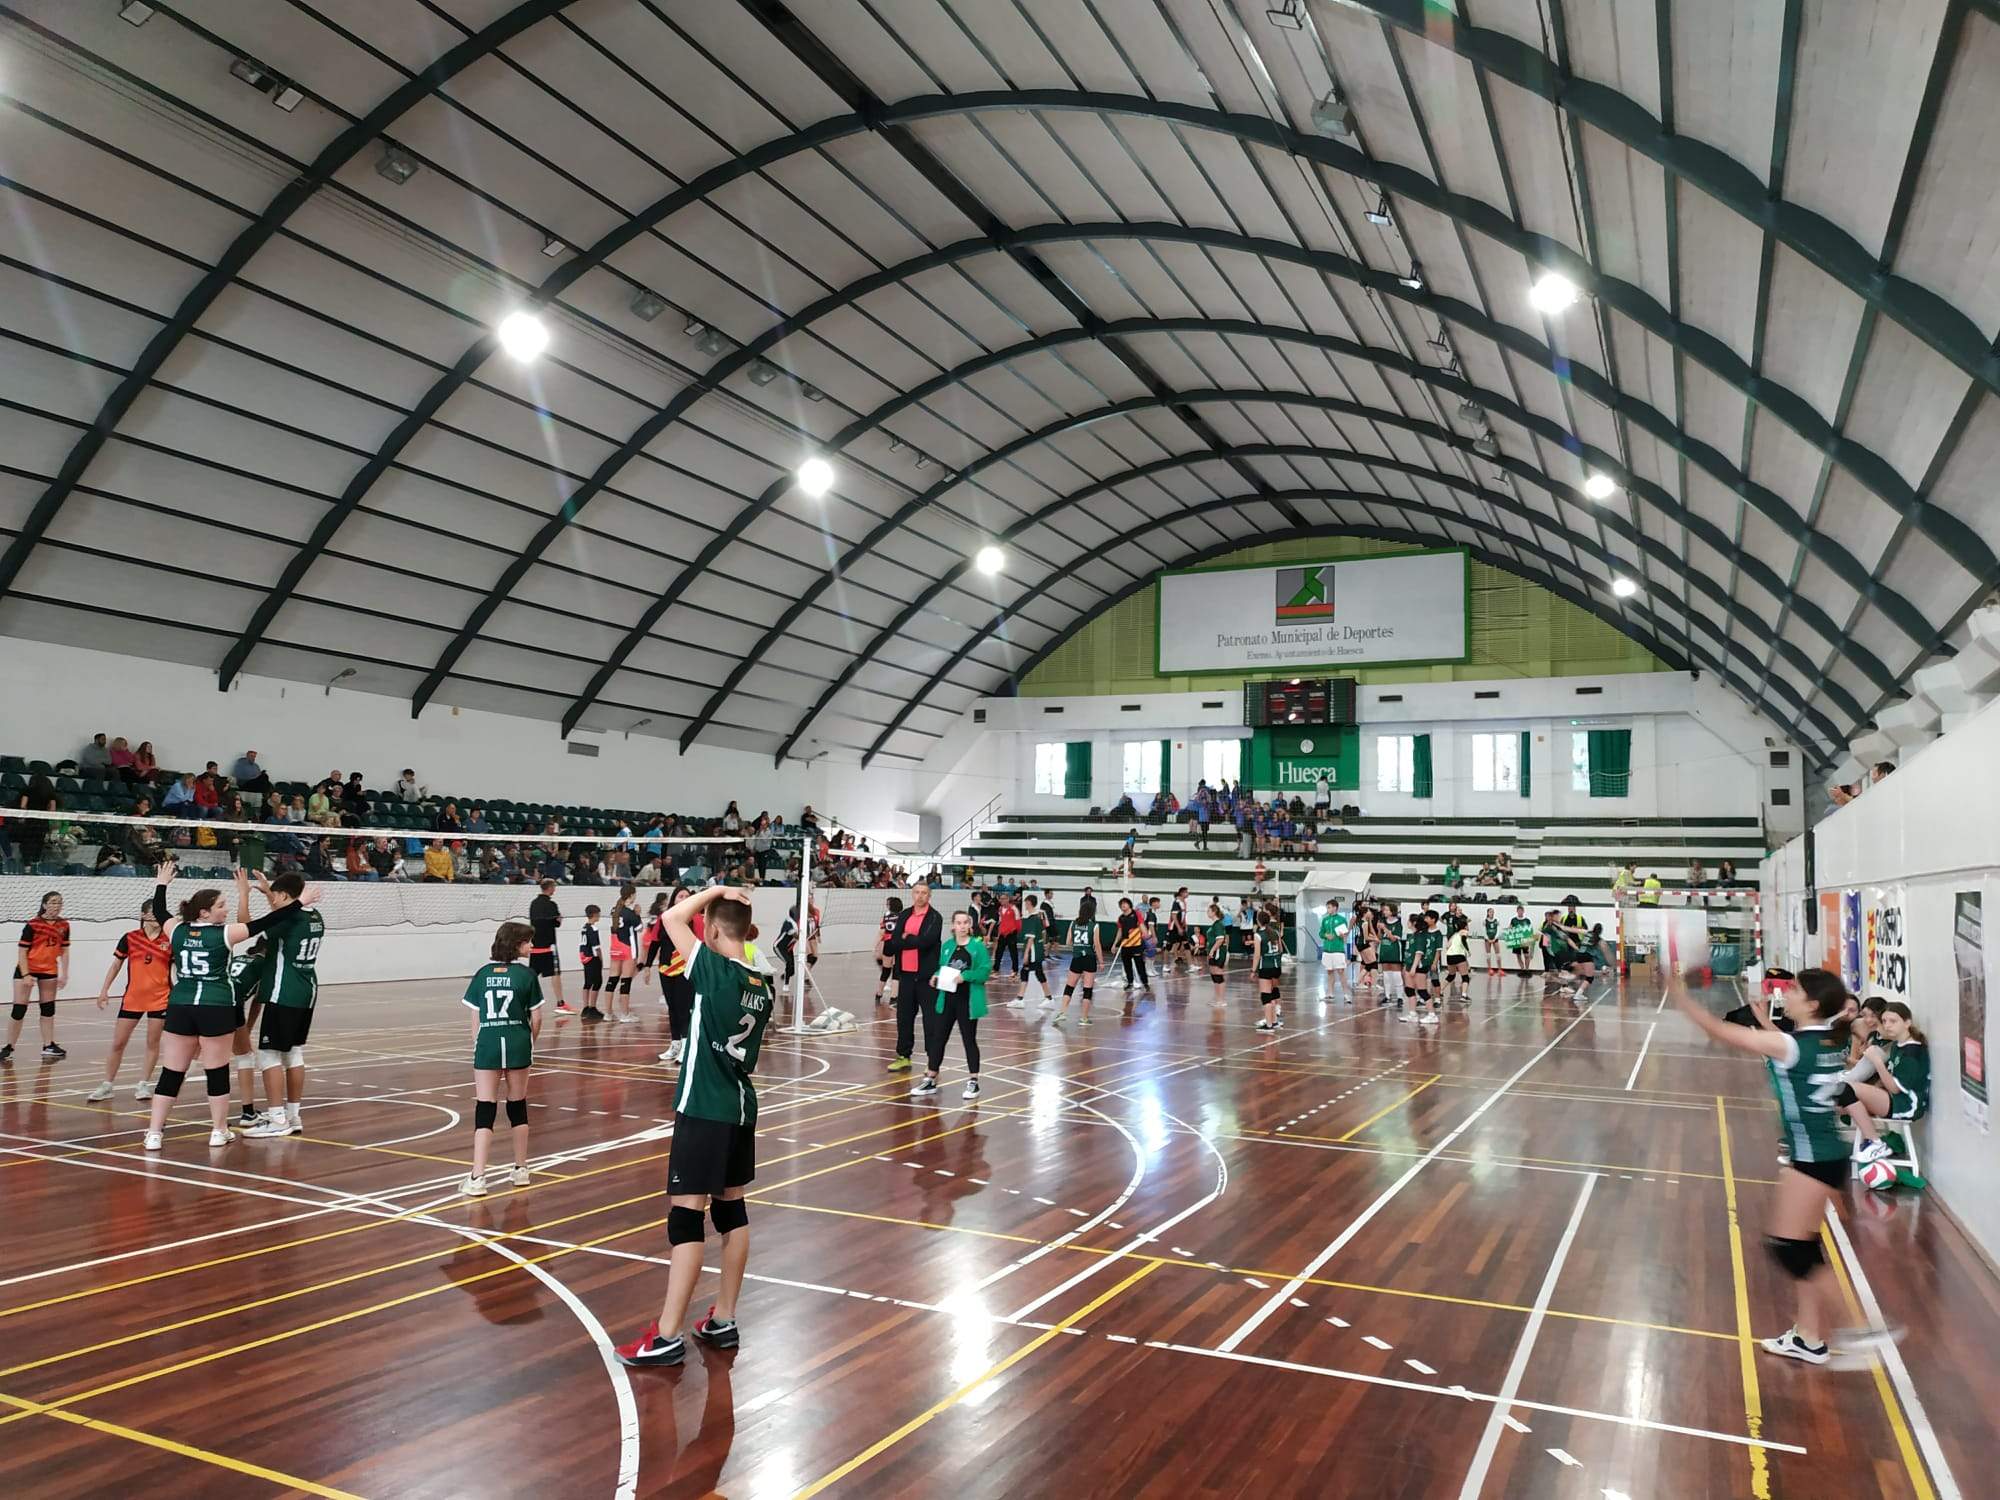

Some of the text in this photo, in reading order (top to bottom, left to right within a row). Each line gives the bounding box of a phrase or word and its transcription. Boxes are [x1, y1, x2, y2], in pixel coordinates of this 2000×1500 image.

[1217, 625, 1394, 648] Patronato Municipal de Deportes
[1336, 646, 1364, 656] Huesca
[1279, 761, 1337, 784] Huesca
[1073, 929, 1088, 945] 24
[296, 937, 320, 961] 10
[180, 949, 210, 976] 15
[486, 976, 511, 987] BERTA
[484, 989, 514, 1020] 17
[740, 990, 765, 1012] MAKS
[724, 1012, 757, 1062] 2
